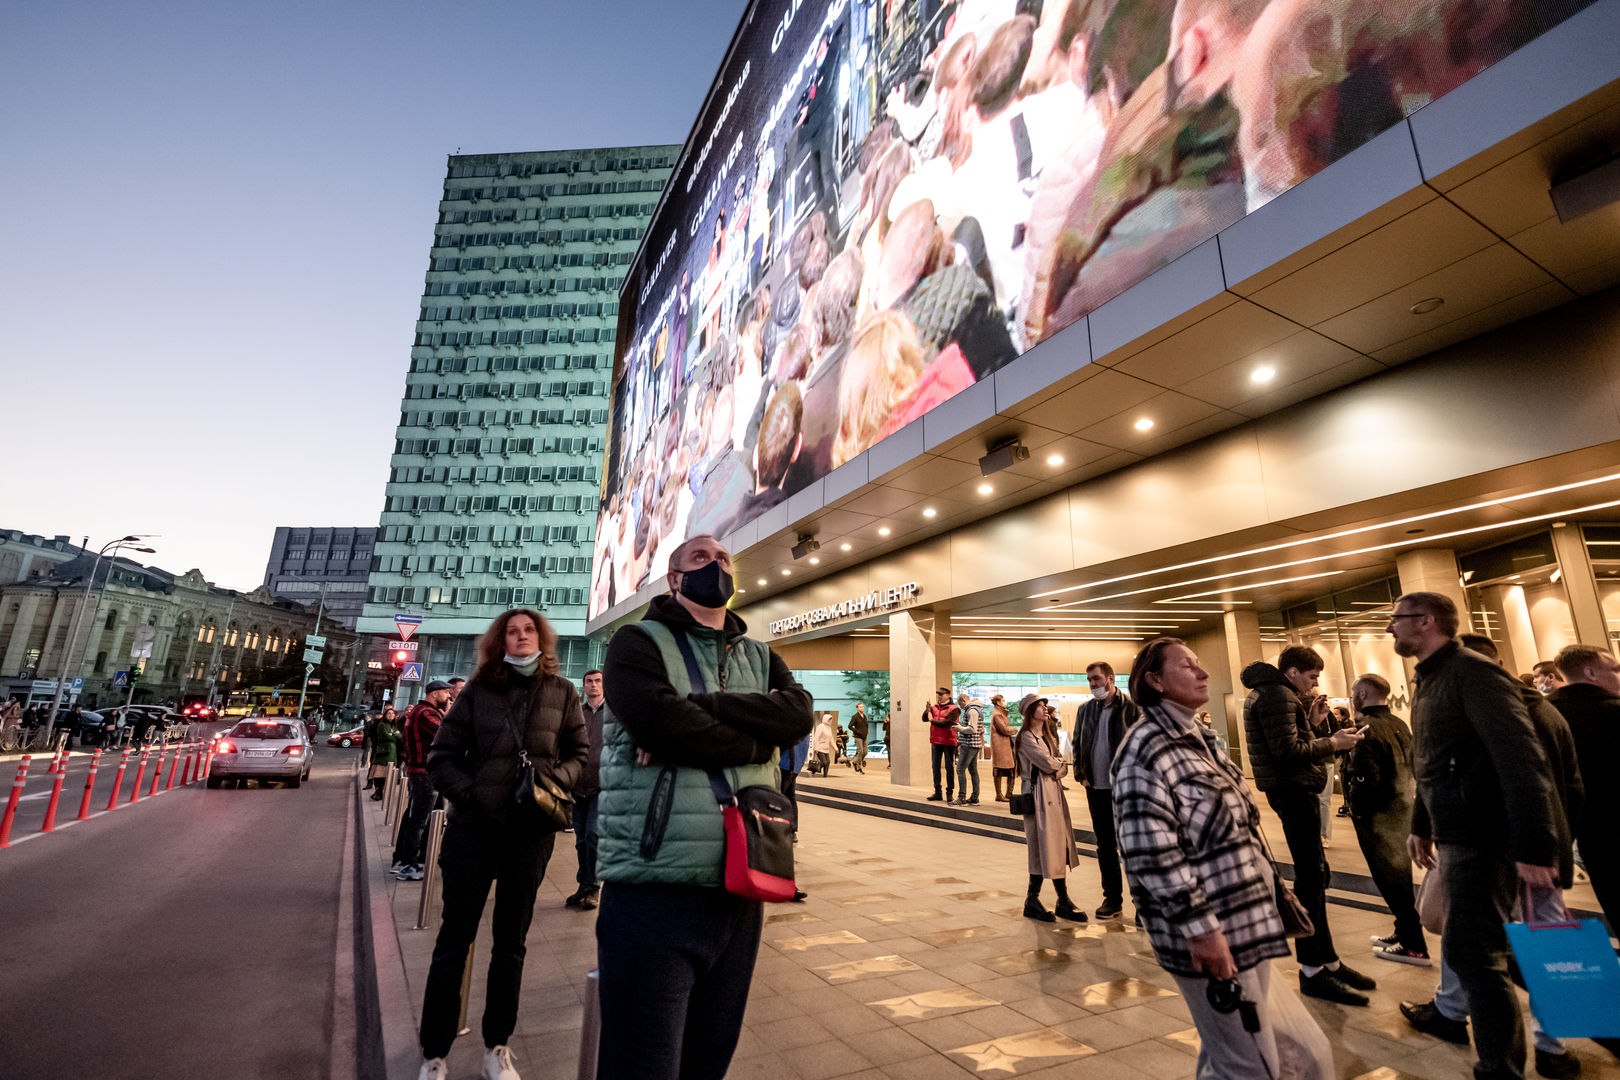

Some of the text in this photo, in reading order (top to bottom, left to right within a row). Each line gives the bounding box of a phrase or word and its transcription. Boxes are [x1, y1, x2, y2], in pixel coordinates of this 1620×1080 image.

[690, 131, 744, 237] GULLIVER
[641, 228, 678, 305] GULLIVER
[768, 581, 918, 635] ТОРГОВО-РОЗВАЖАЛЬНИЙ ЦЕНТР
